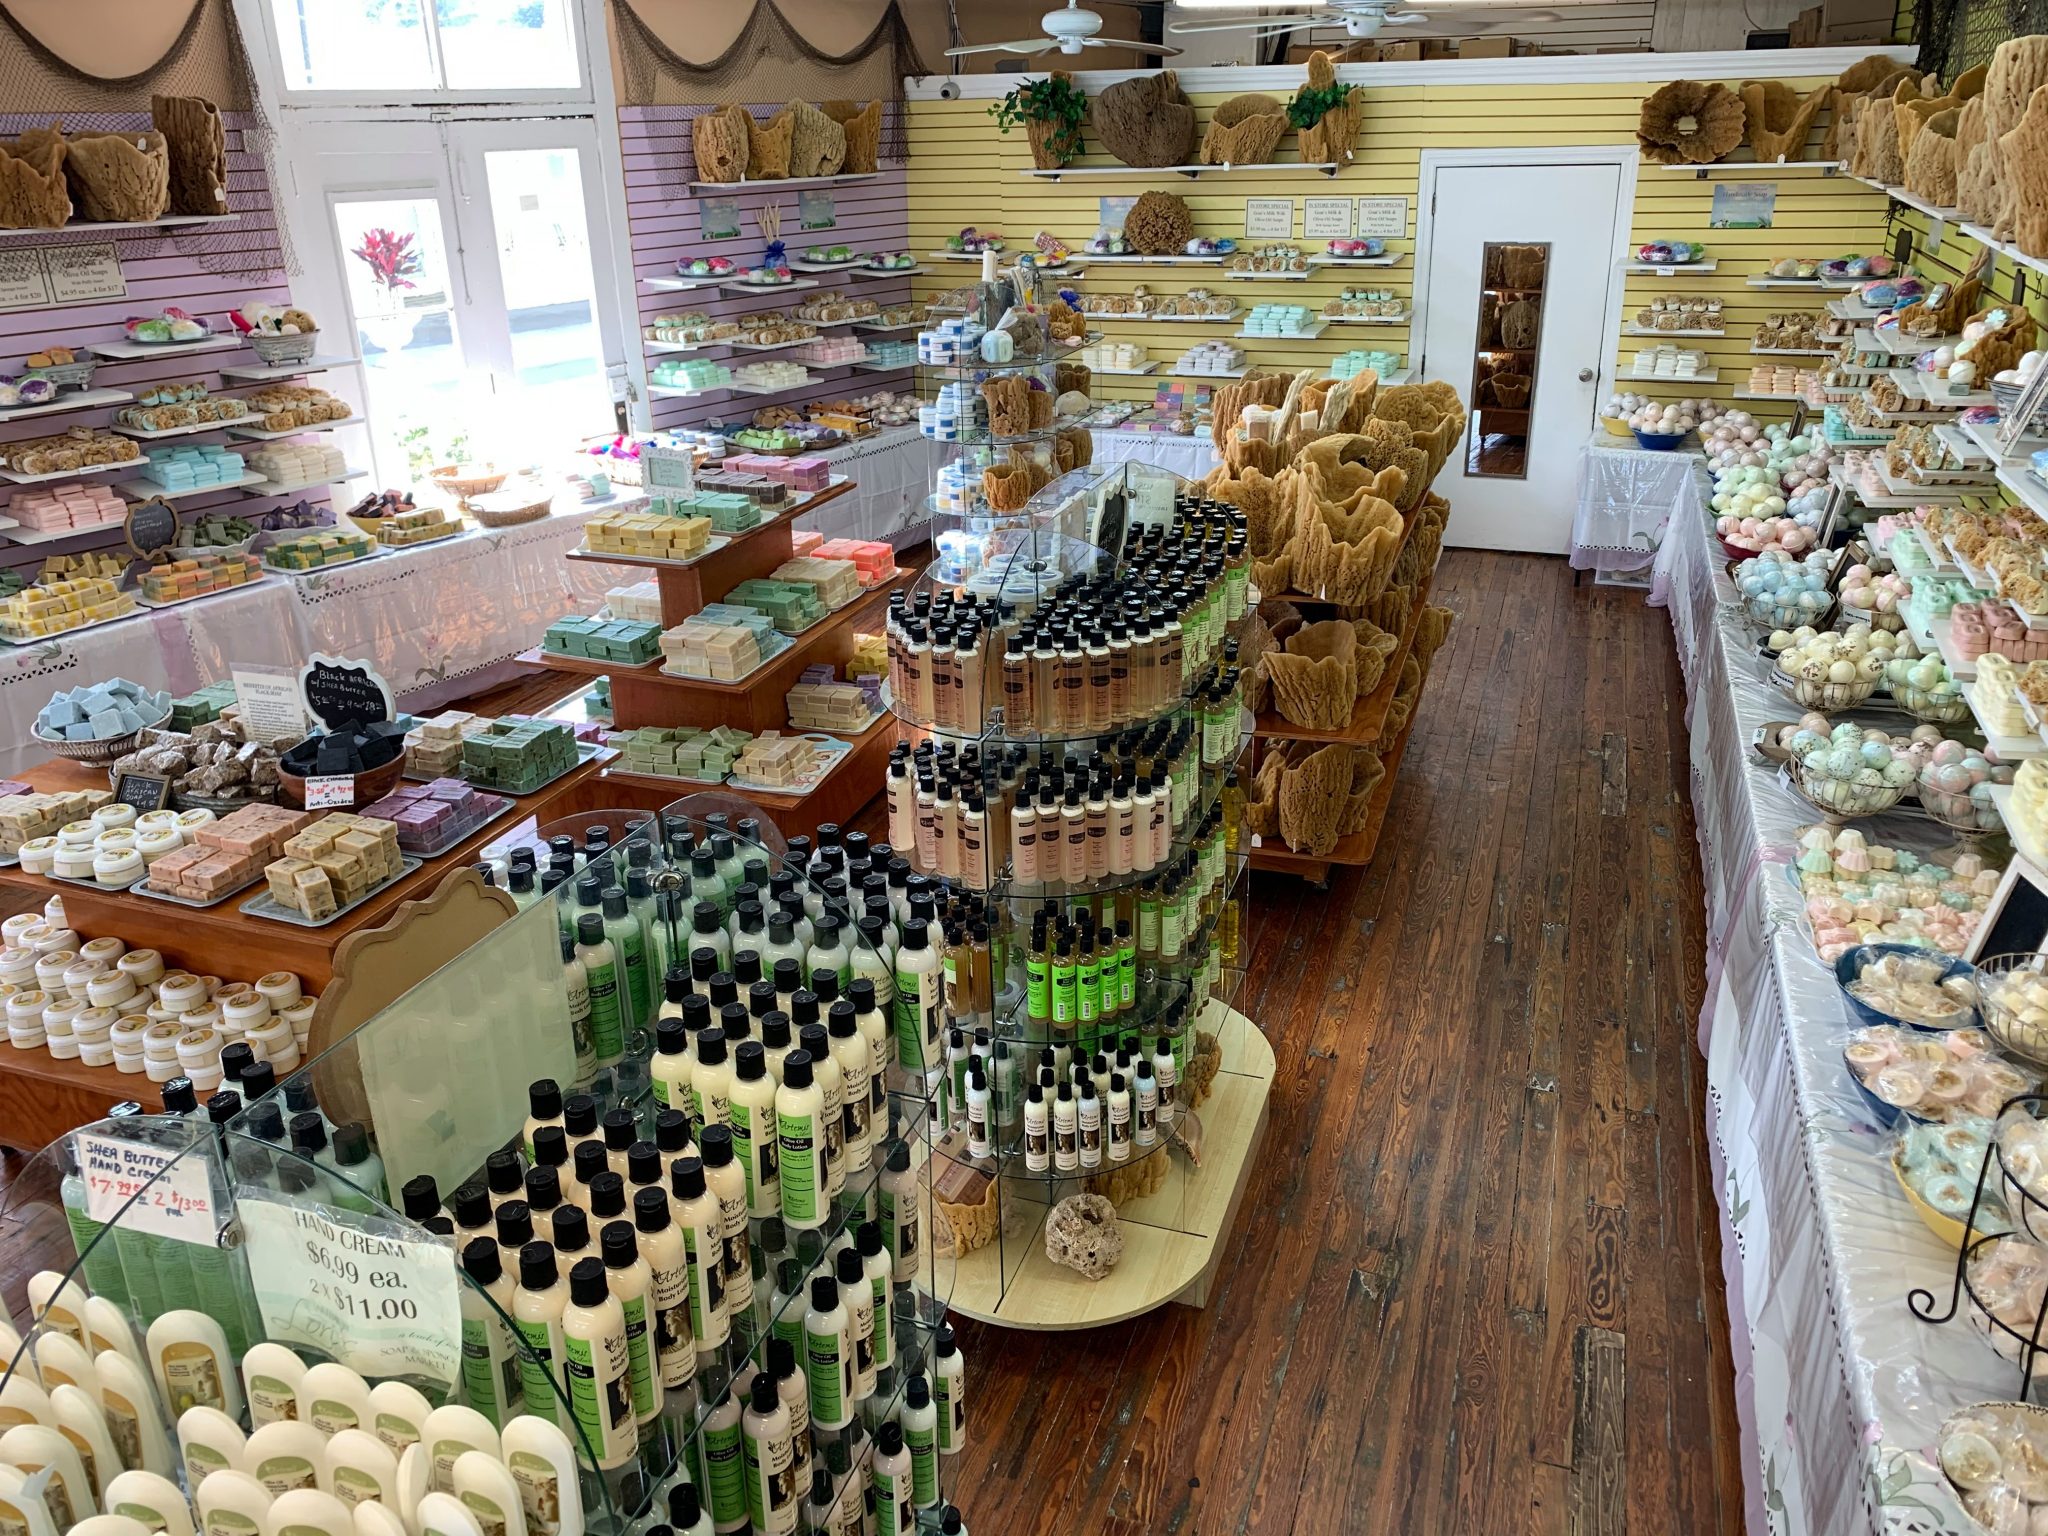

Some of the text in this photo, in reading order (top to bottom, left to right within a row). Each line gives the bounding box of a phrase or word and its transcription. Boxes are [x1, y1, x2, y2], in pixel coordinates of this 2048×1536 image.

[319, 669, 345, 681] Black
[86, 1141, 118, 1160] SHEA
[792, 1142, 808, 1150] Lotion
[88, 1156, 122, 1175] HAND
[154, 1191, 166, 1207] 2
[294, 1210, 406, 1259] HAND CREAM
[306, 1240, 408, 1289] $6.99 ea.
[309, 1278, 319, 1294] 2
[333, 1286, 418, 1320] $11.00
[658, 1295, 676, 1303] Body
[380, 1345, 408, 1356] SOAP
